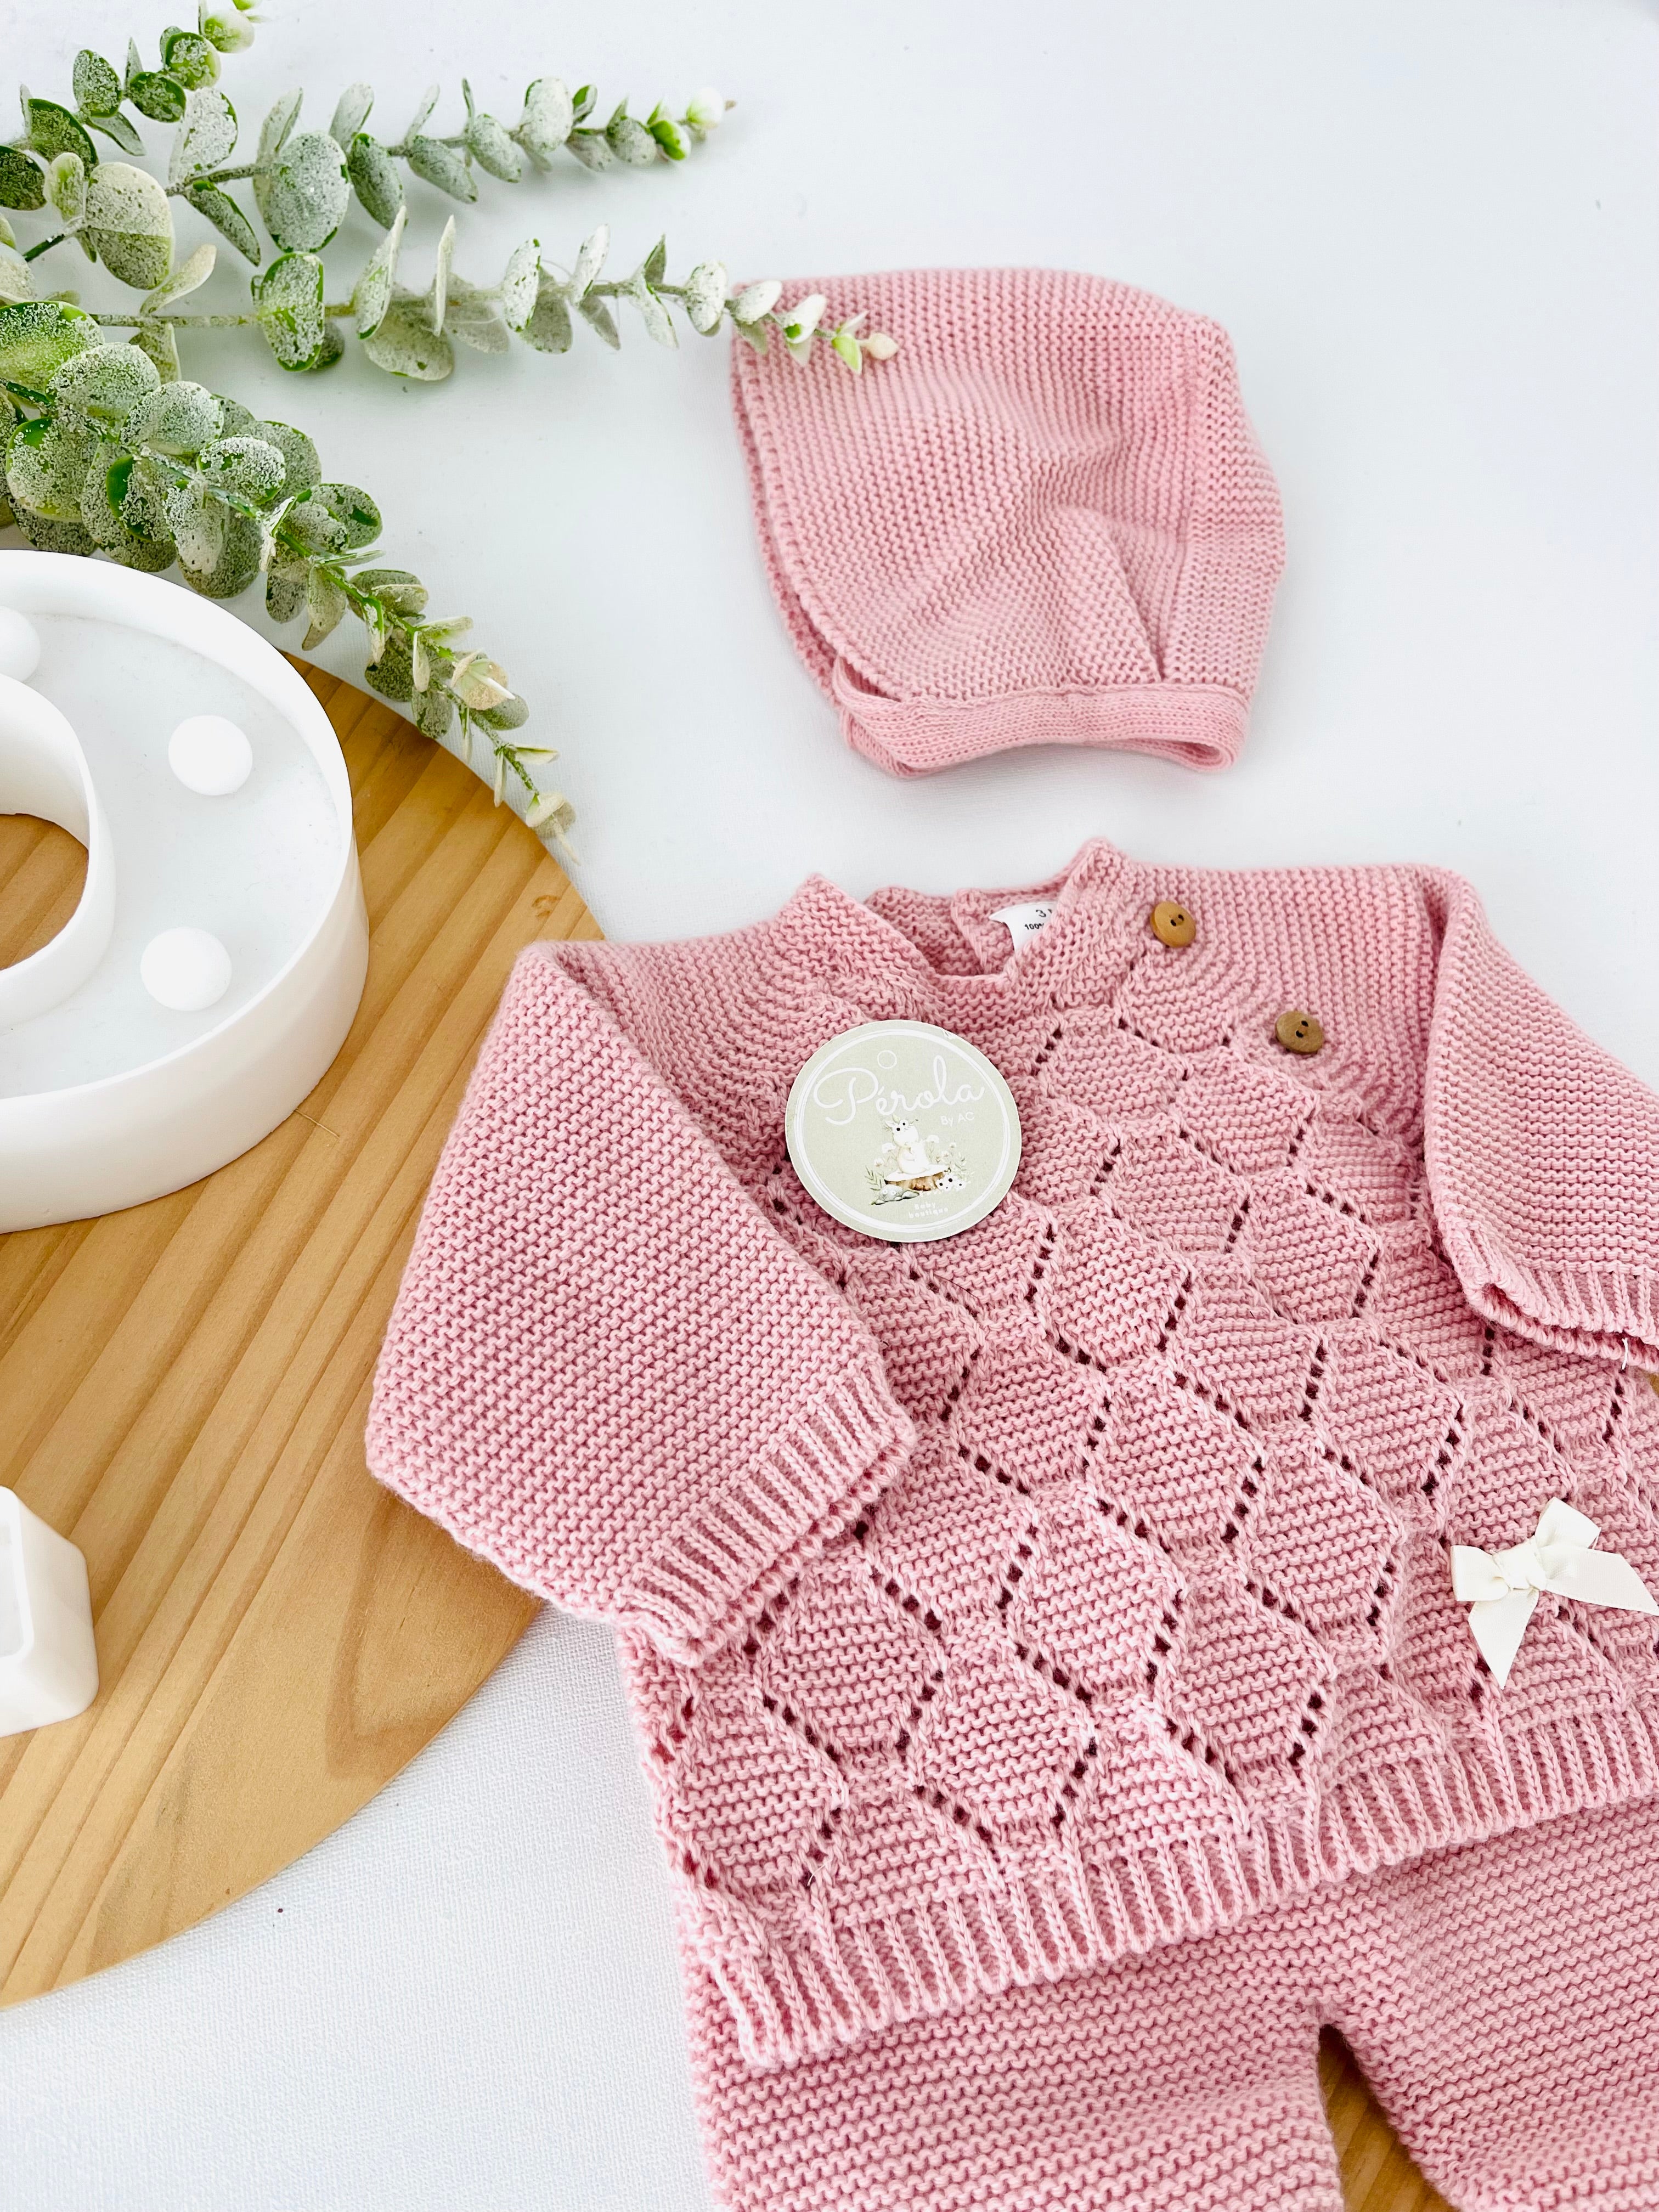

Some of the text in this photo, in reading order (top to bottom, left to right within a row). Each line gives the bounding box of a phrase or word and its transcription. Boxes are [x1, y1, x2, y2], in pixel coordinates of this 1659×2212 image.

[1035, 909, 1047, 918] 3
[813, 1054, 985, 1125] Pérola
[940, 1111, 975, 1127] By AC
